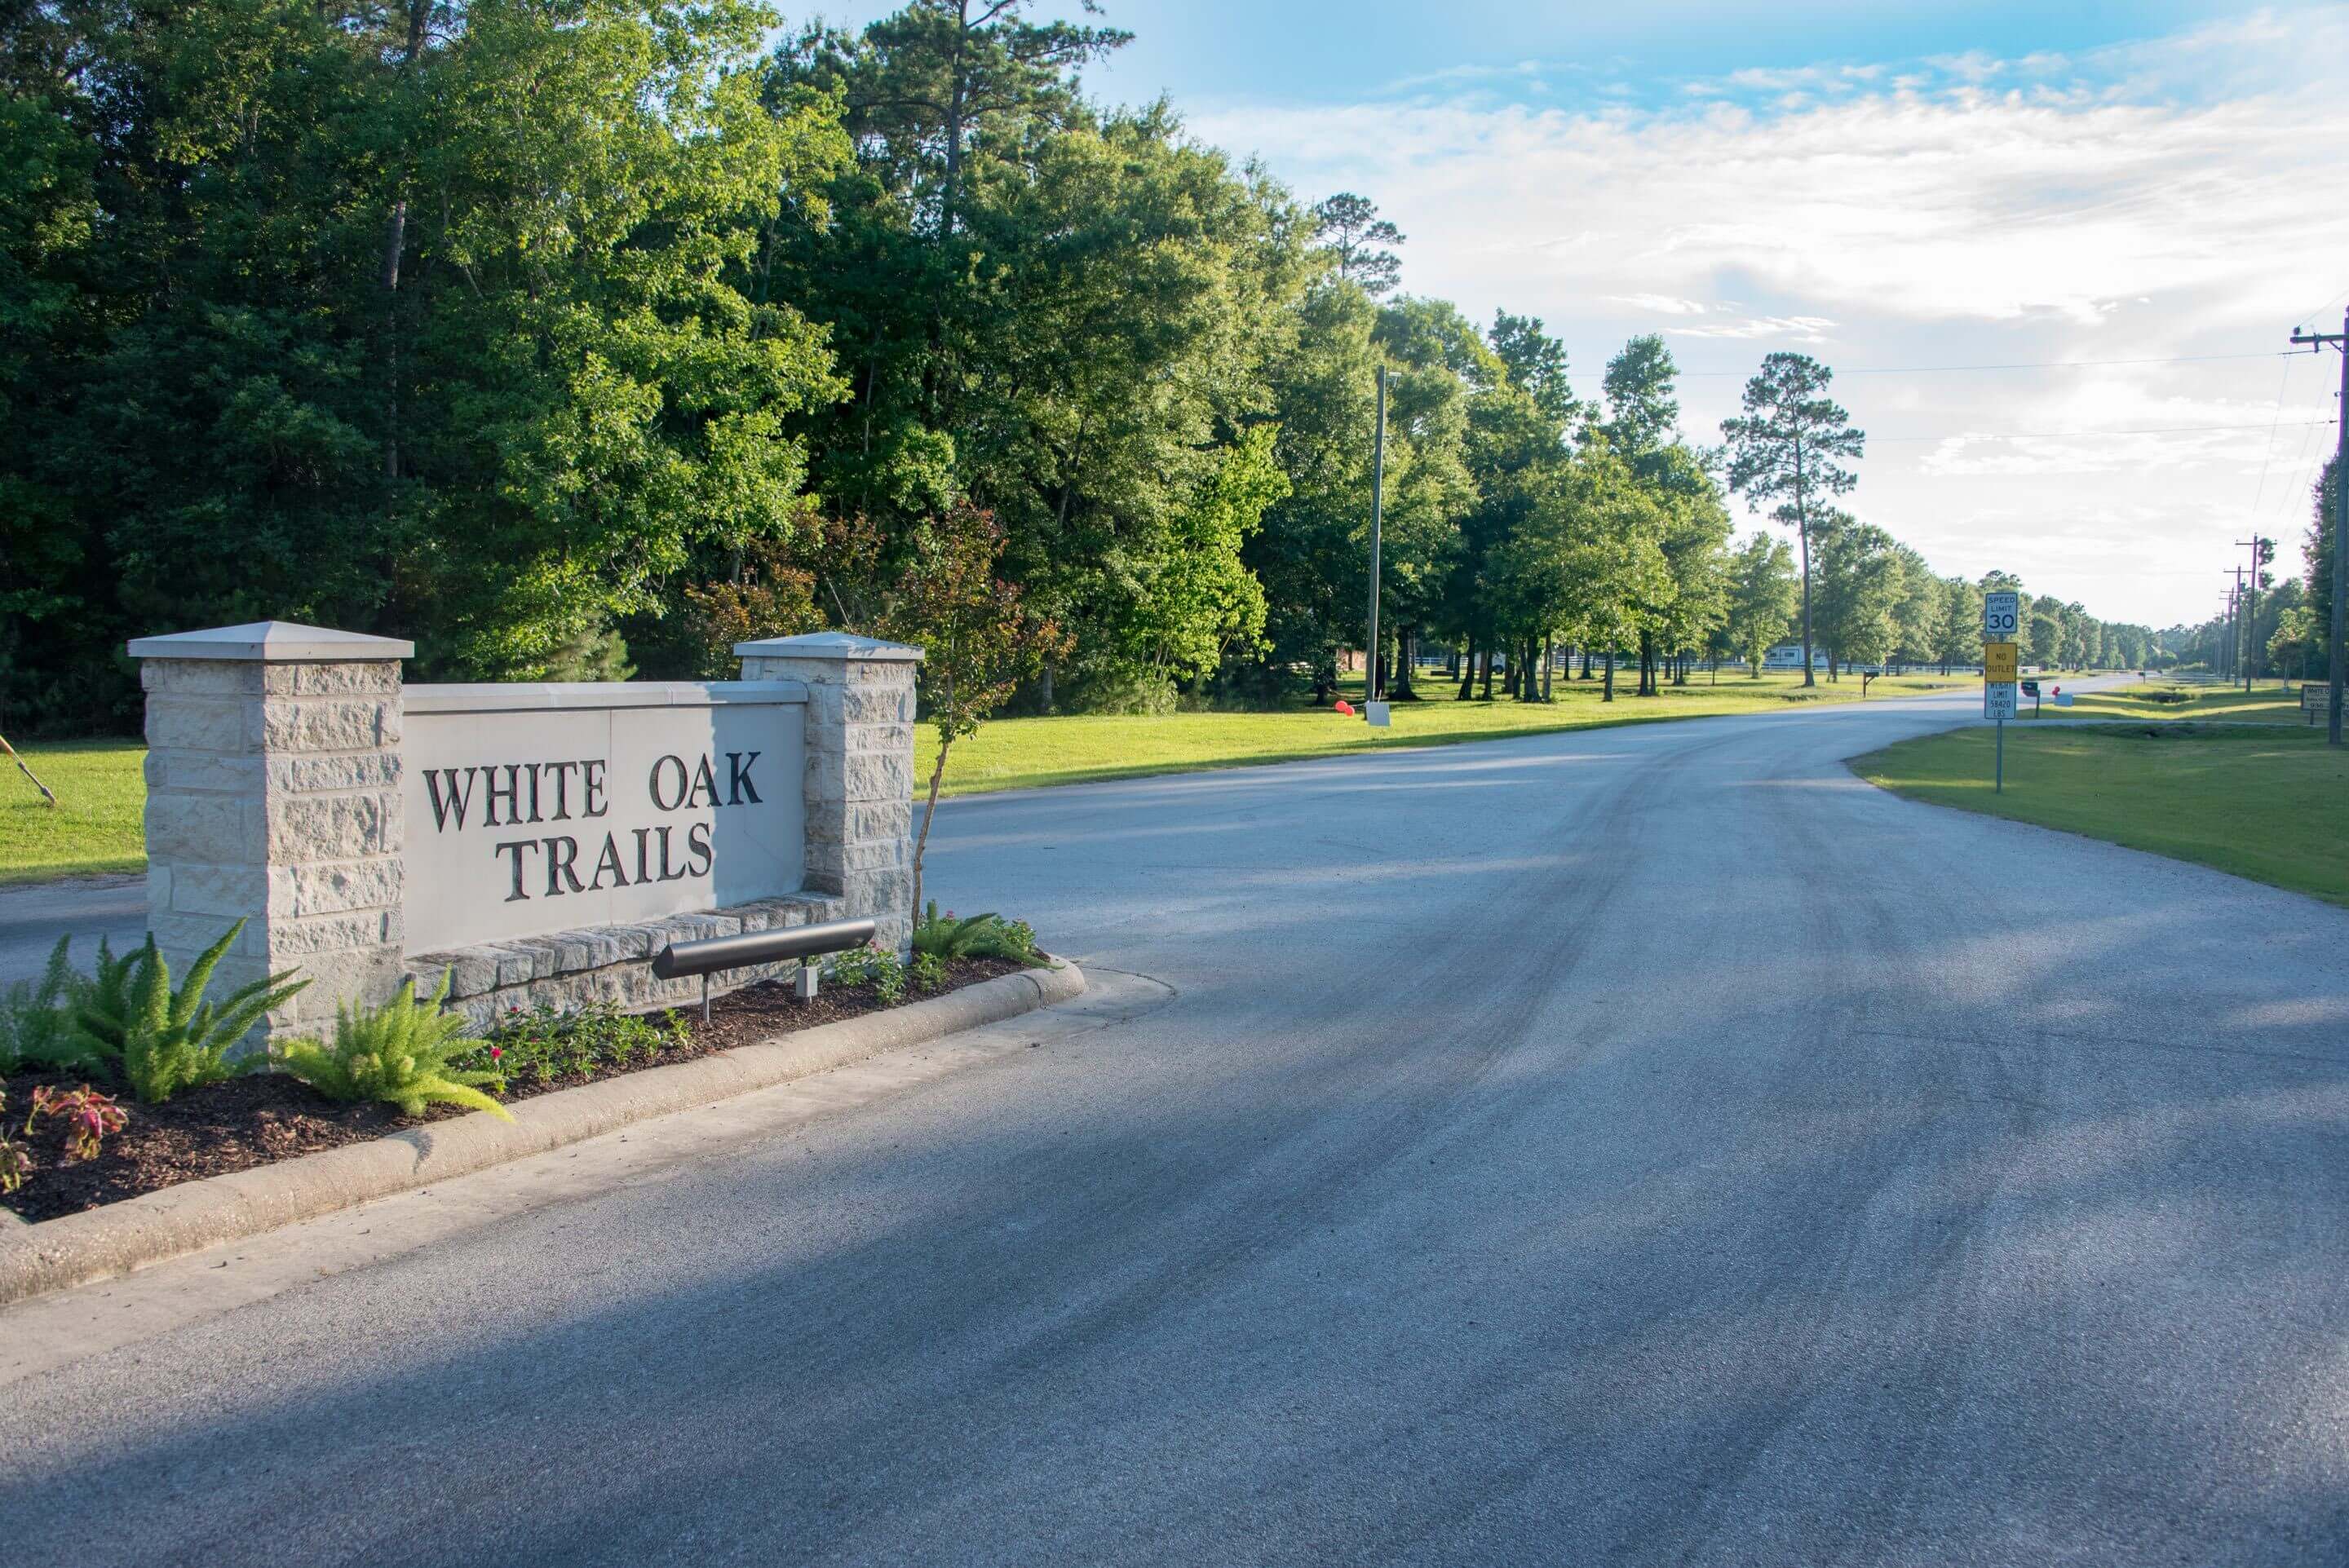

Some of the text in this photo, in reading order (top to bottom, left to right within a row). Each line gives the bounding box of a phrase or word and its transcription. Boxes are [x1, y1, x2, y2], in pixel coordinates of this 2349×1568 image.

[1988, 614, 2015, 629] 30
[1993, 709, 2006, 718] LBS
[422, 751, 763, 833] WHITE OAK
[495, 822, 713, 903] TRAILS
